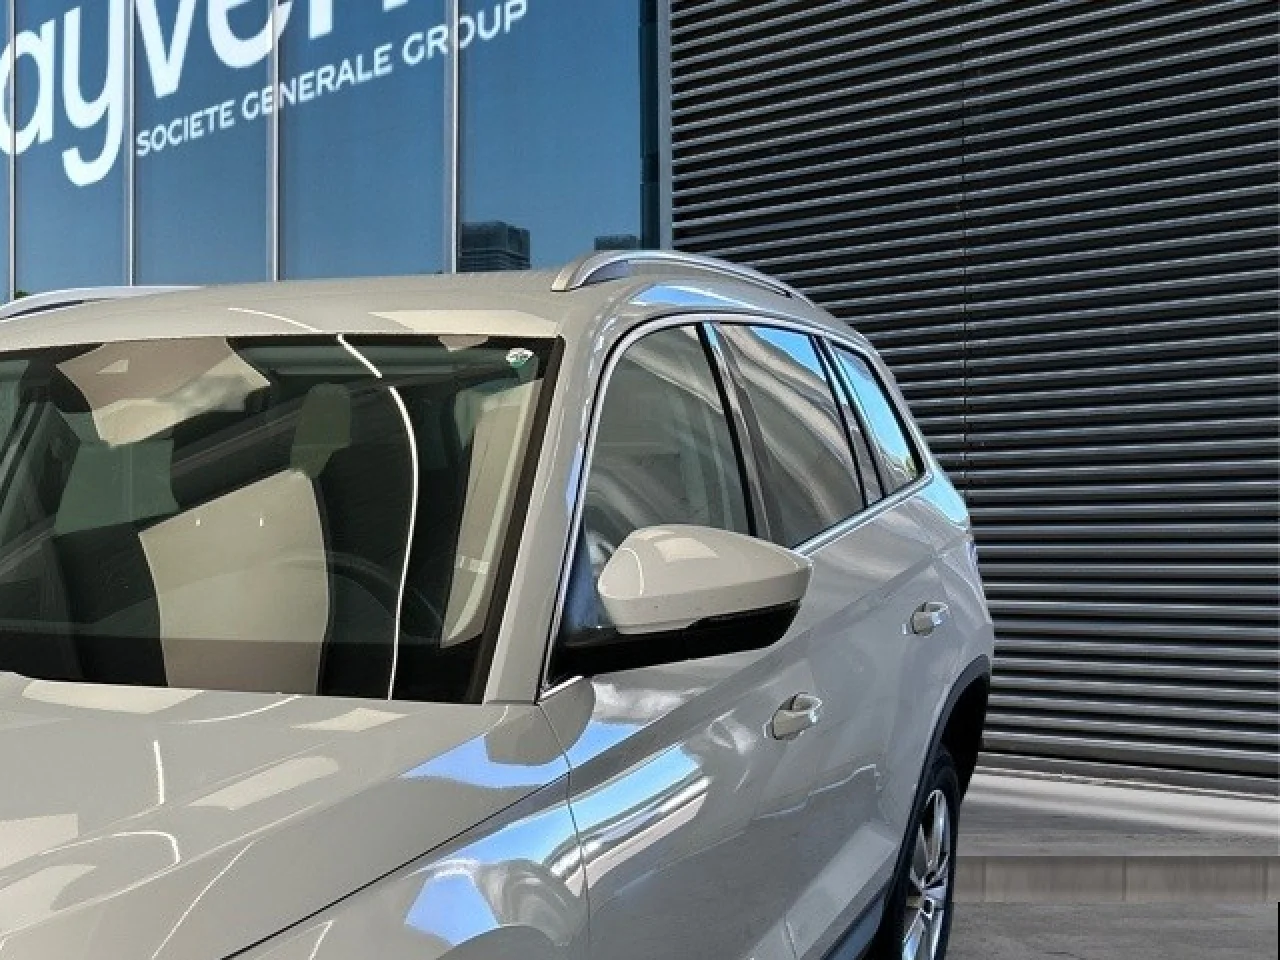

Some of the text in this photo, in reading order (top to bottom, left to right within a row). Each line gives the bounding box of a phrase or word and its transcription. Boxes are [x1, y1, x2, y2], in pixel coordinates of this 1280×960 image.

[136, 0, 527, 157] SOCIETE GENERALE GROUP
